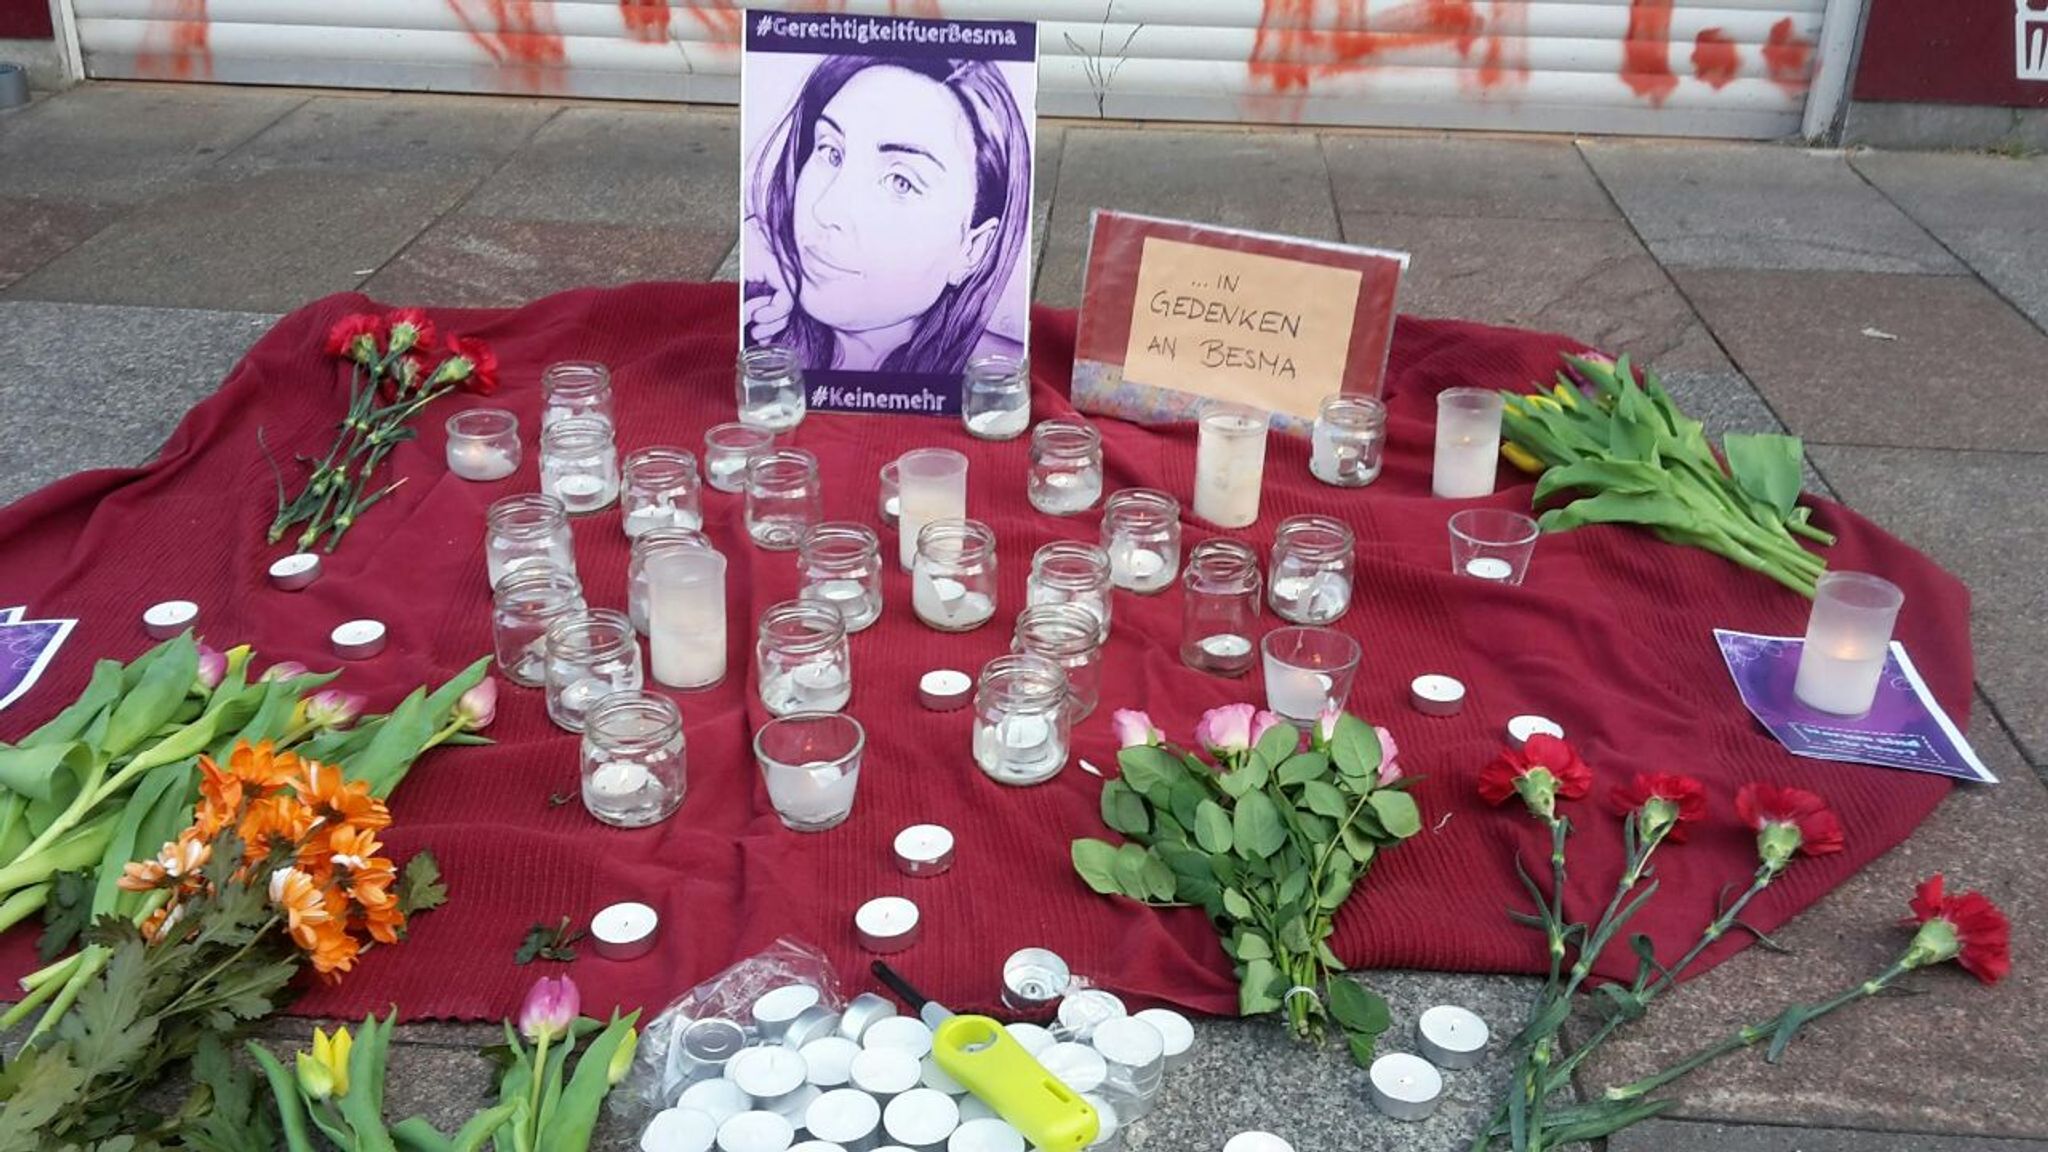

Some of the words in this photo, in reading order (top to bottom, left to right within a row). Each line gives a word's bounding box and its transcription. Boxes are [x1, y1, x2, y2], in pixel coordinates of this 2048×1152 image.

[756, 15, 1017, 46] #GerechtigkeitfuerBesma
[1150, 290, 1301, 337] GEDENKEN
[1147, 335, 1177, 361] AN
[1199, 339, 1297, 379] BESMA
[811, 385, 946, 411] #Keinemehr
